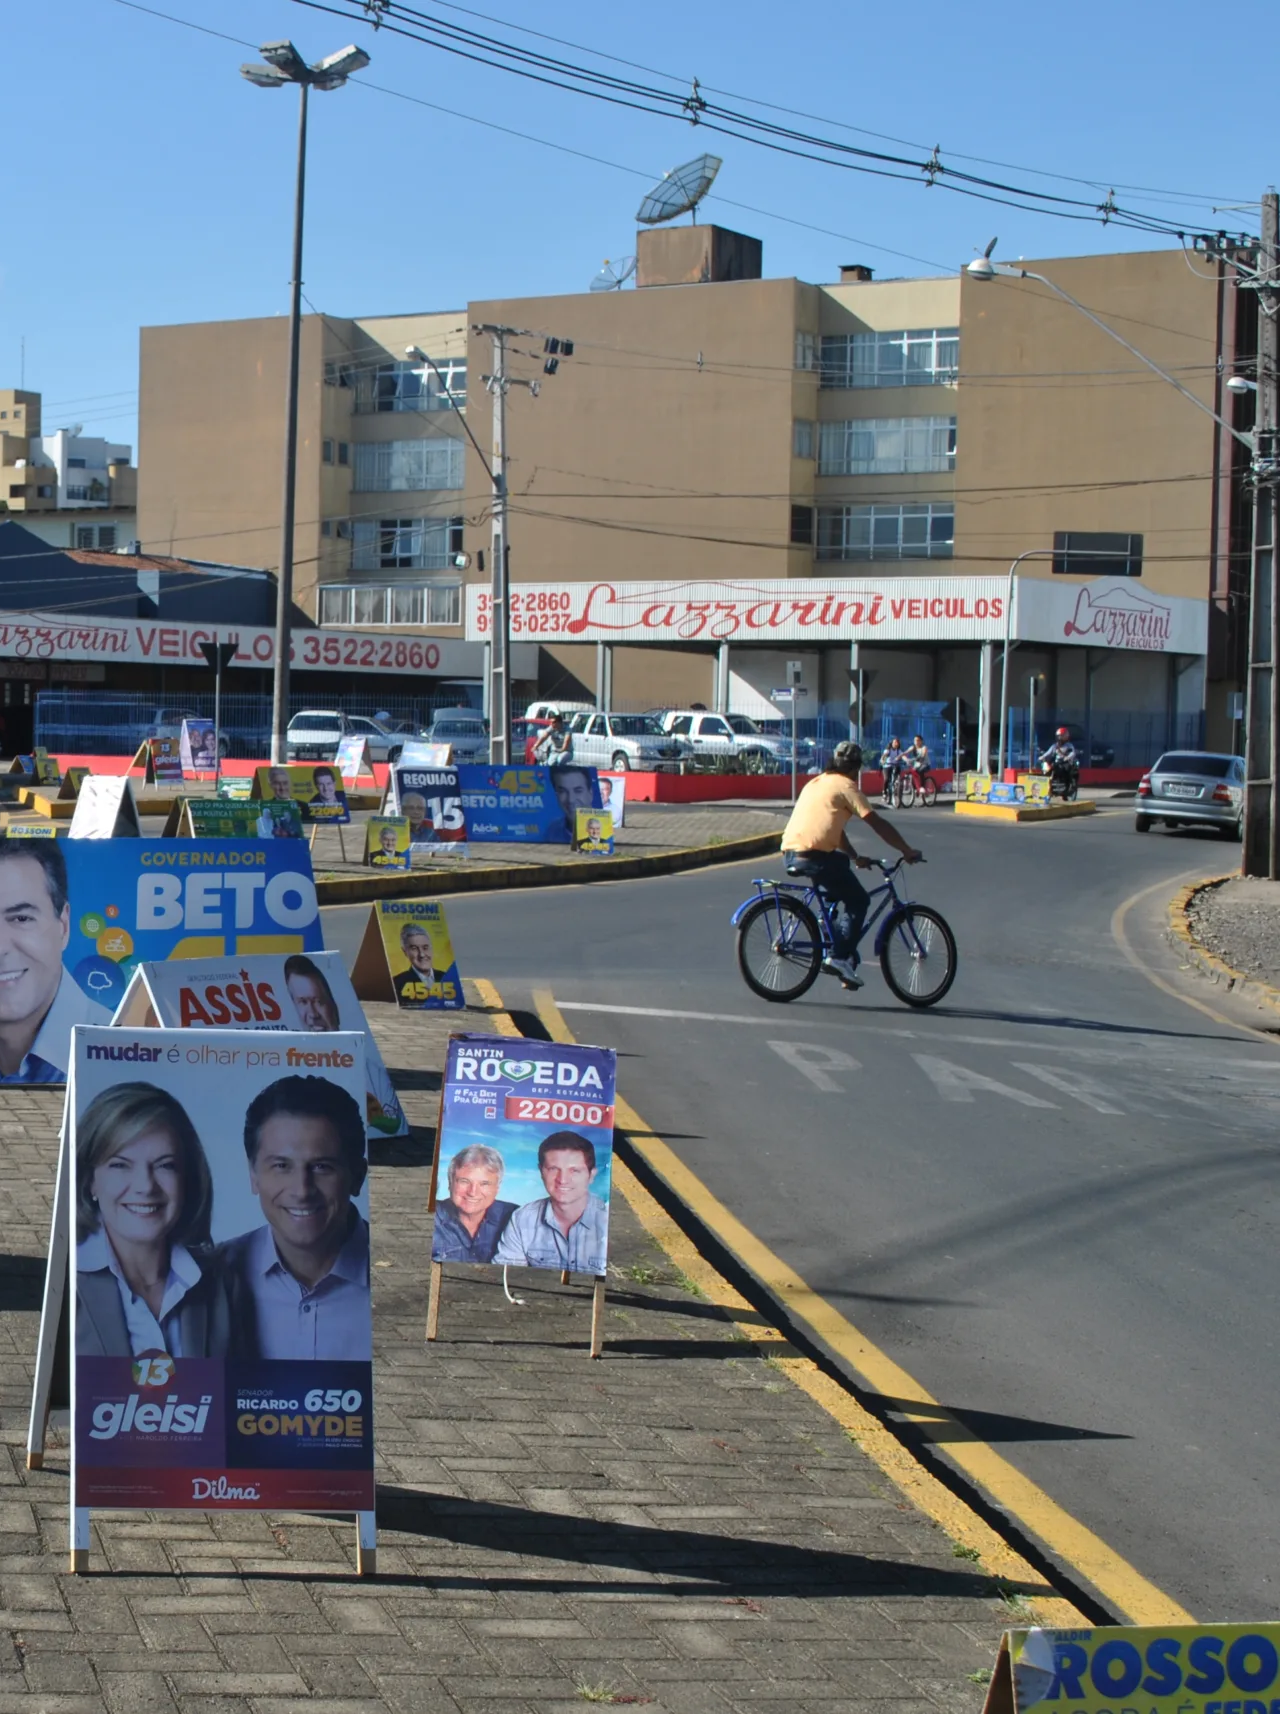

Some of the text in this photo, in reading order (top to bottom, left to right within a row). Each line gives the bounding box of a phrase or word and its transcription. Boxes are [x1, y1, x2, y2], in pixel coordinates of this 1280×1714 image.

[568, 584, 1003, 638] Lazzarini VEICULOS
[1064, 587, 1171, 645] Lazzarini
[1125, 637, 1165, 650] VEICULOS
[500, 770, 537, 794] 45
[427, 796, 465, 830] 15
[461, 795, 544, 808] BETO RICHA
[140, 852, 266, 866] GOVERNADOR
[136, 871, 318, 930] BETO
[381, 903, 439, 914] ROSSONI
[401, 981, 456, 1000] 4545
[179, 979, 282, 1028] ASSIS
[86, 1042, 355, 1070] mudar é olhar pra frente
[458, 1048, 504, 1058] SANTIN
[556, 1089, 603, 1099] ESTADUAL
[518, 1100, 603, 1125] 22000
[137, 1358, 173, 1386] 13
[236, 1388, 363, 1413] RICARDO 650
[237, 1388, 274, 1397] SENADOR
[88, 1393, 213, 1440] gleisi
[236, 1413, 363, 1437] GOMYDE
[191, 1476, 261, 1501] Dilma
